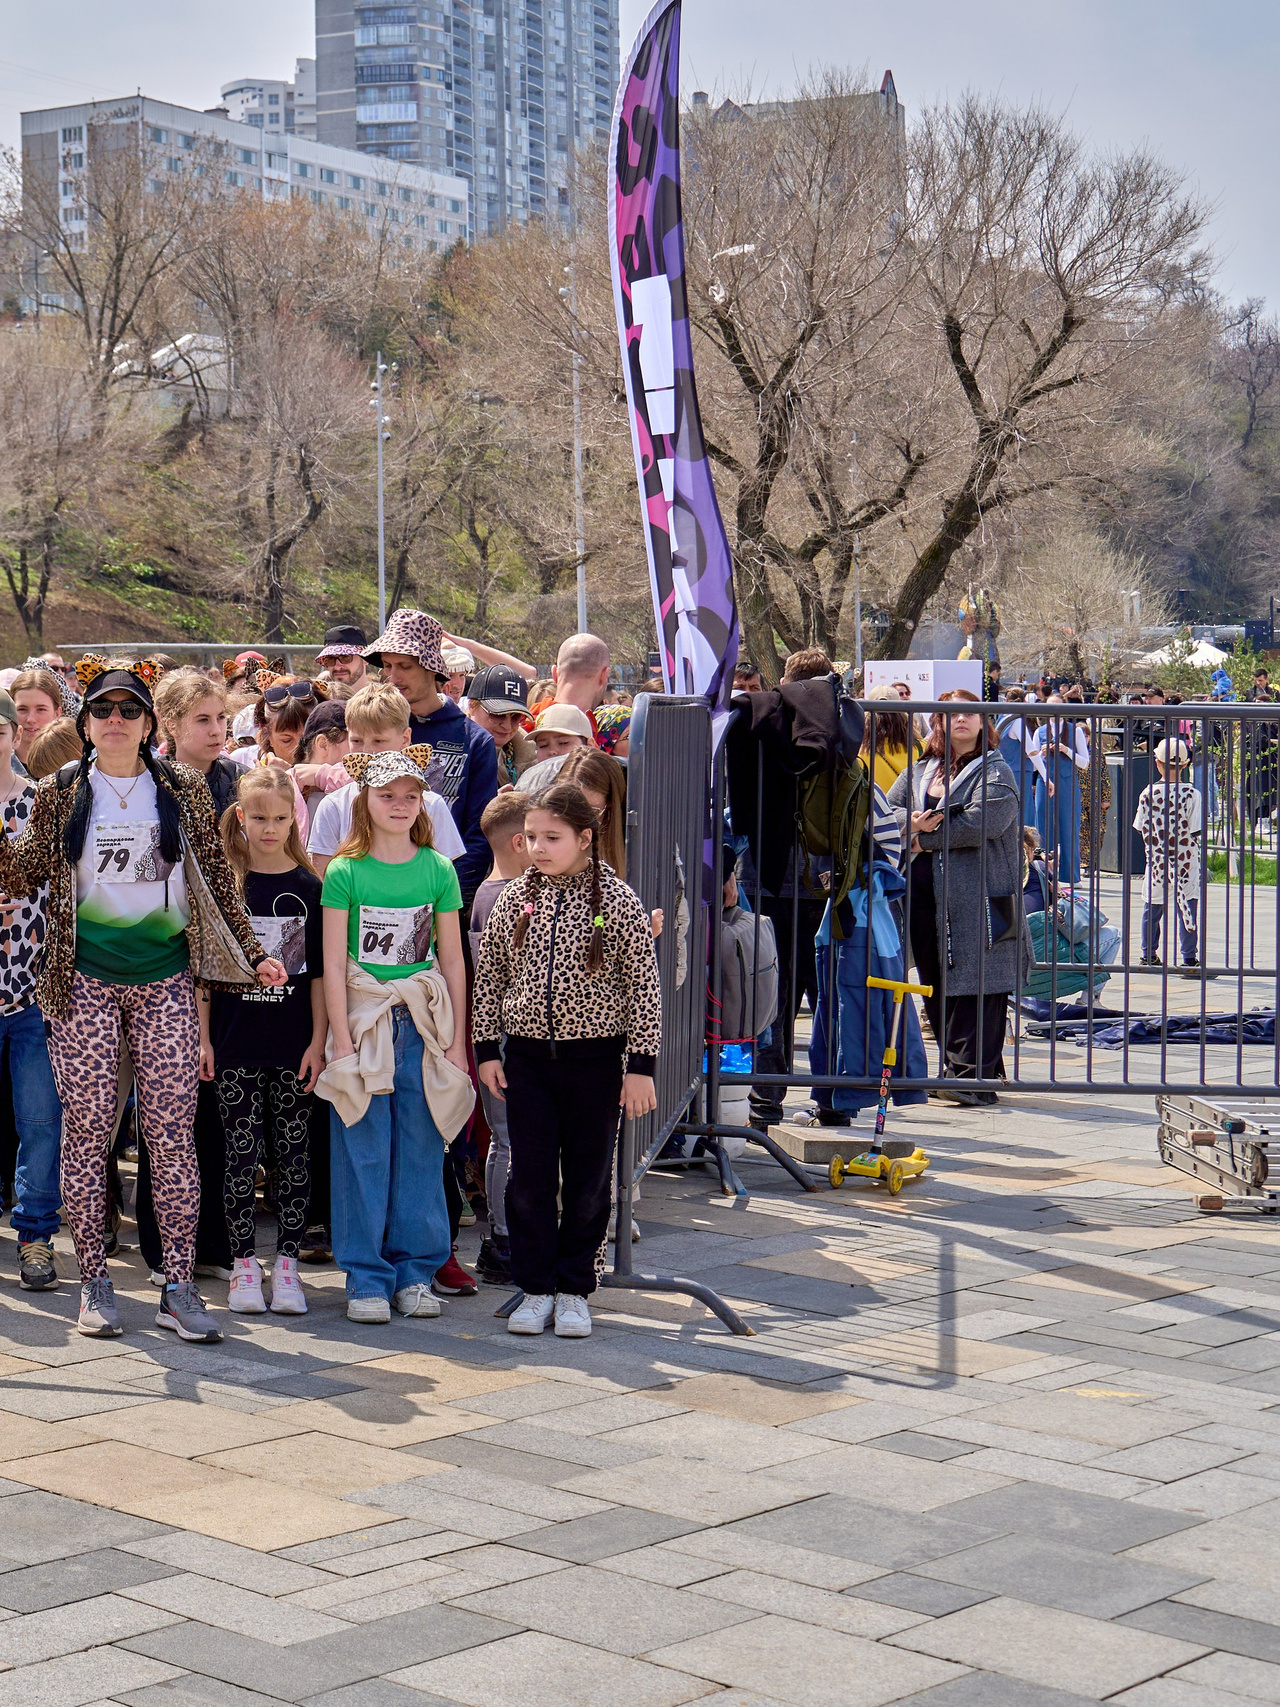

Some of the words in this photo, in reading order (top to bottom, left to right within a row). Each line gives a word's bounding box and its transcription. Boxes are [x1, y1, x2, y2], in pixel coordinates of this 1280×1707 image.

[97, 848, 130, 873] 79
[362, 931, 394, 956] 04
[242, 993, 285, 1003] DISNEY
